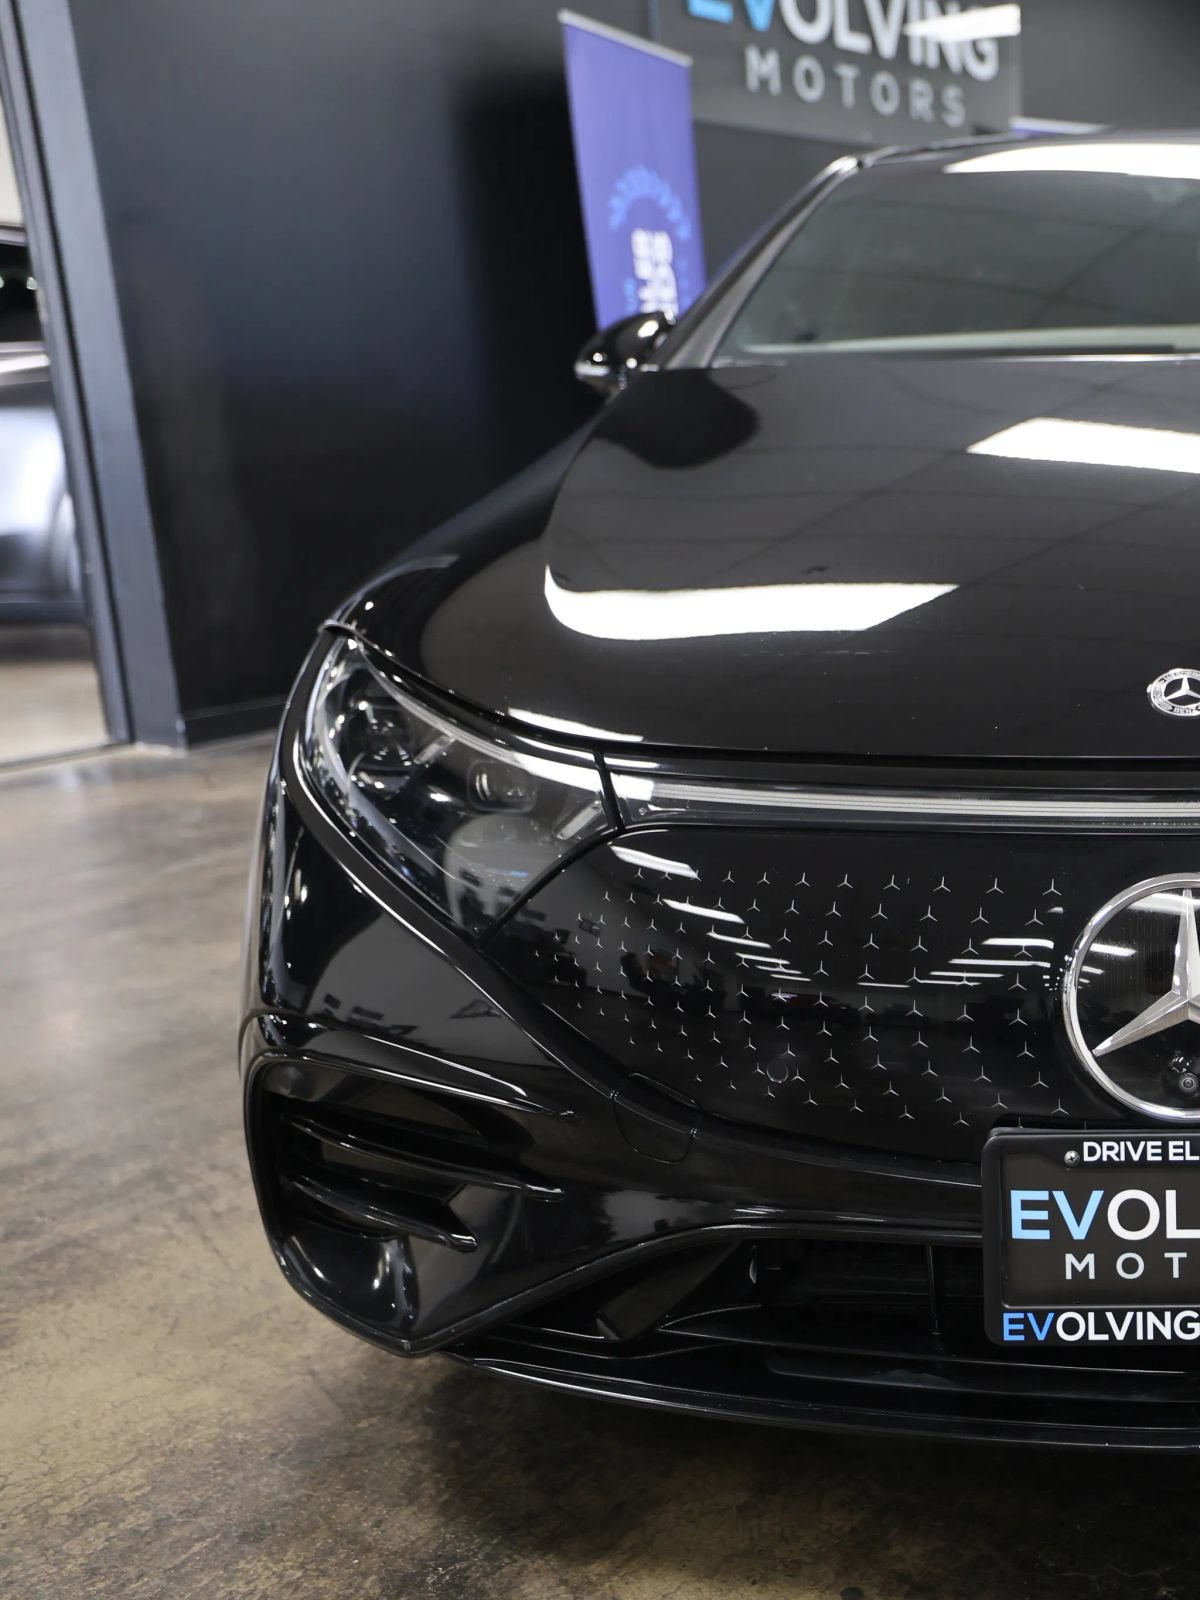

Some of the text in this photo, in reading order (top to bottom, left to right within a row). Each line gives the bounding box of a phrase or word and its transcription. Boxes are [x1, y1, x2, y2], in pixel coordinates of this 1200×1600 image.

[687, 0, 1001, 82] OLVING
[744, 44, 967, 128] MOTORS
[1082, 1140, 1163, 1163] DRIVE
[1002, 1310, 1200, 1342] EVOLVING
